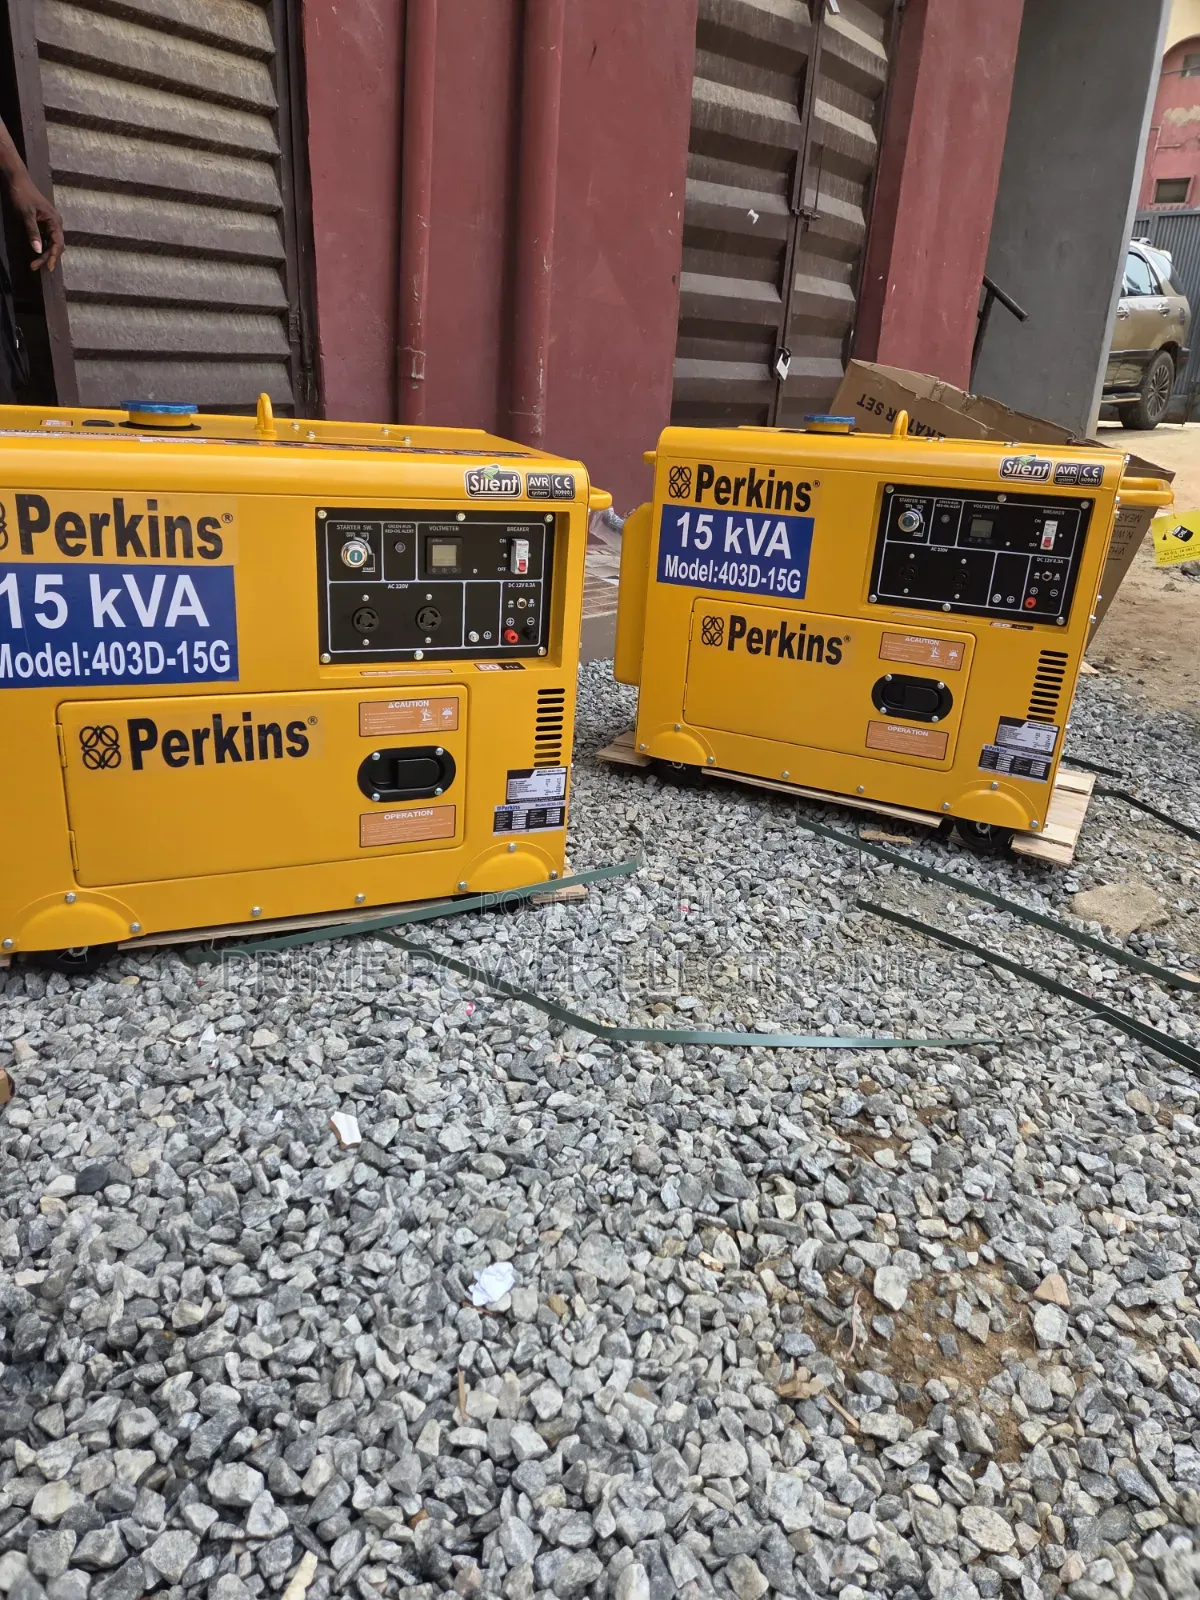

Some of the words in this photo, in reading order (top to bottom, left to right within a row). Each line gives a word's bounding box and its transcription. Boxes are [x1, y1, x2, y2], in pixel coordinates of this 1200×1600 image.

[856, 394, 885, 415] SET
[1004, 460, 1049, 476] Silent
[1056, 466, 1078, 475] AVR
[470, 474, 518, 491] Silent
[529, 477, 549, 487] AVR
[676, 511, 713, 550] 15
[723, 516, 792, 560] kVA
[664, 554, 801, 593] Model:403D-15G
[0, 573, 68, 629] 15
[89, 574, 210, 628] kVA
[911, 636, 940, 646] CAUTION
[394, 700, 430, 708] CAUTION
[887, 725, 929, 737] OPERATION
[384, 809, 434, 820] OPERATION
